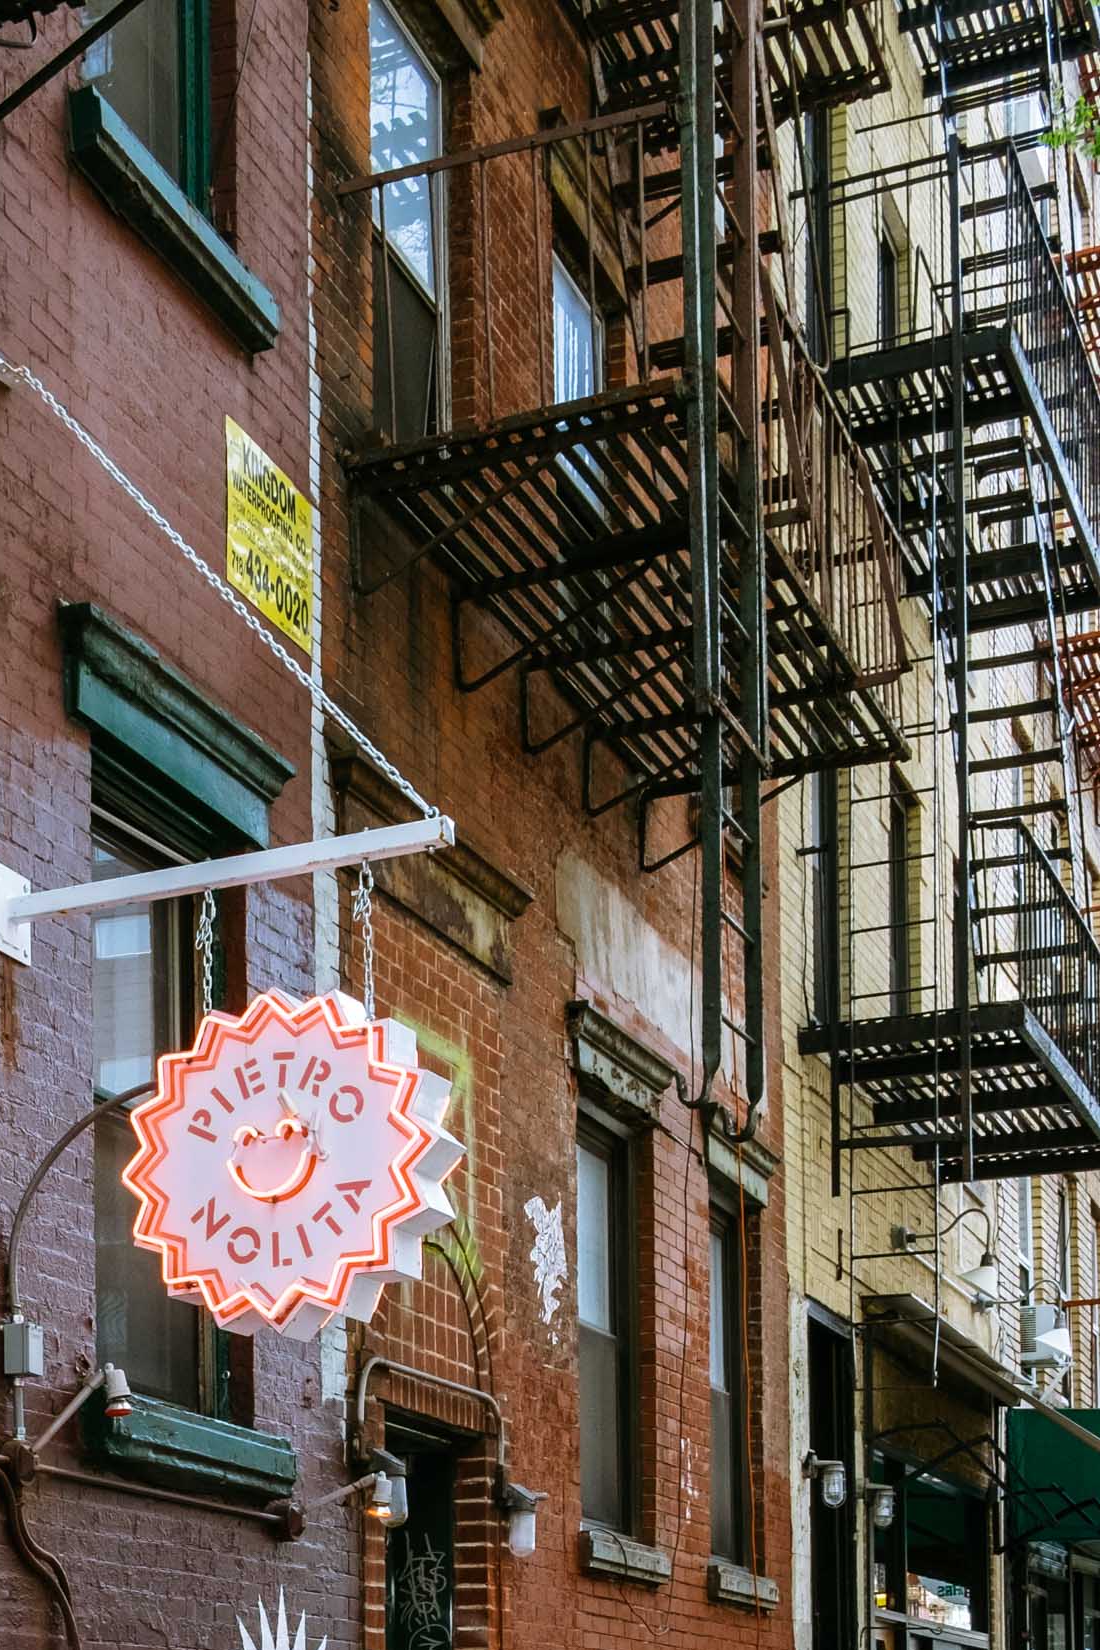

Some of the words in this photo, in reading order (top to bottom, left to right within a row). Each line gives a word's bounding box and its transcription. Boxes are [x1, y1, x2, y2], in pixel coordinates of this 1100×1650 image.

[232, 469, 293, 543] WATERPROOFING
[243, 441, 297, 524] KINGDOM
[246, 548, 309, 636] 434-0020
[187, 1051, 365, 1143] PIETRO
[190, 1179, 373, 1268] NOLITA
